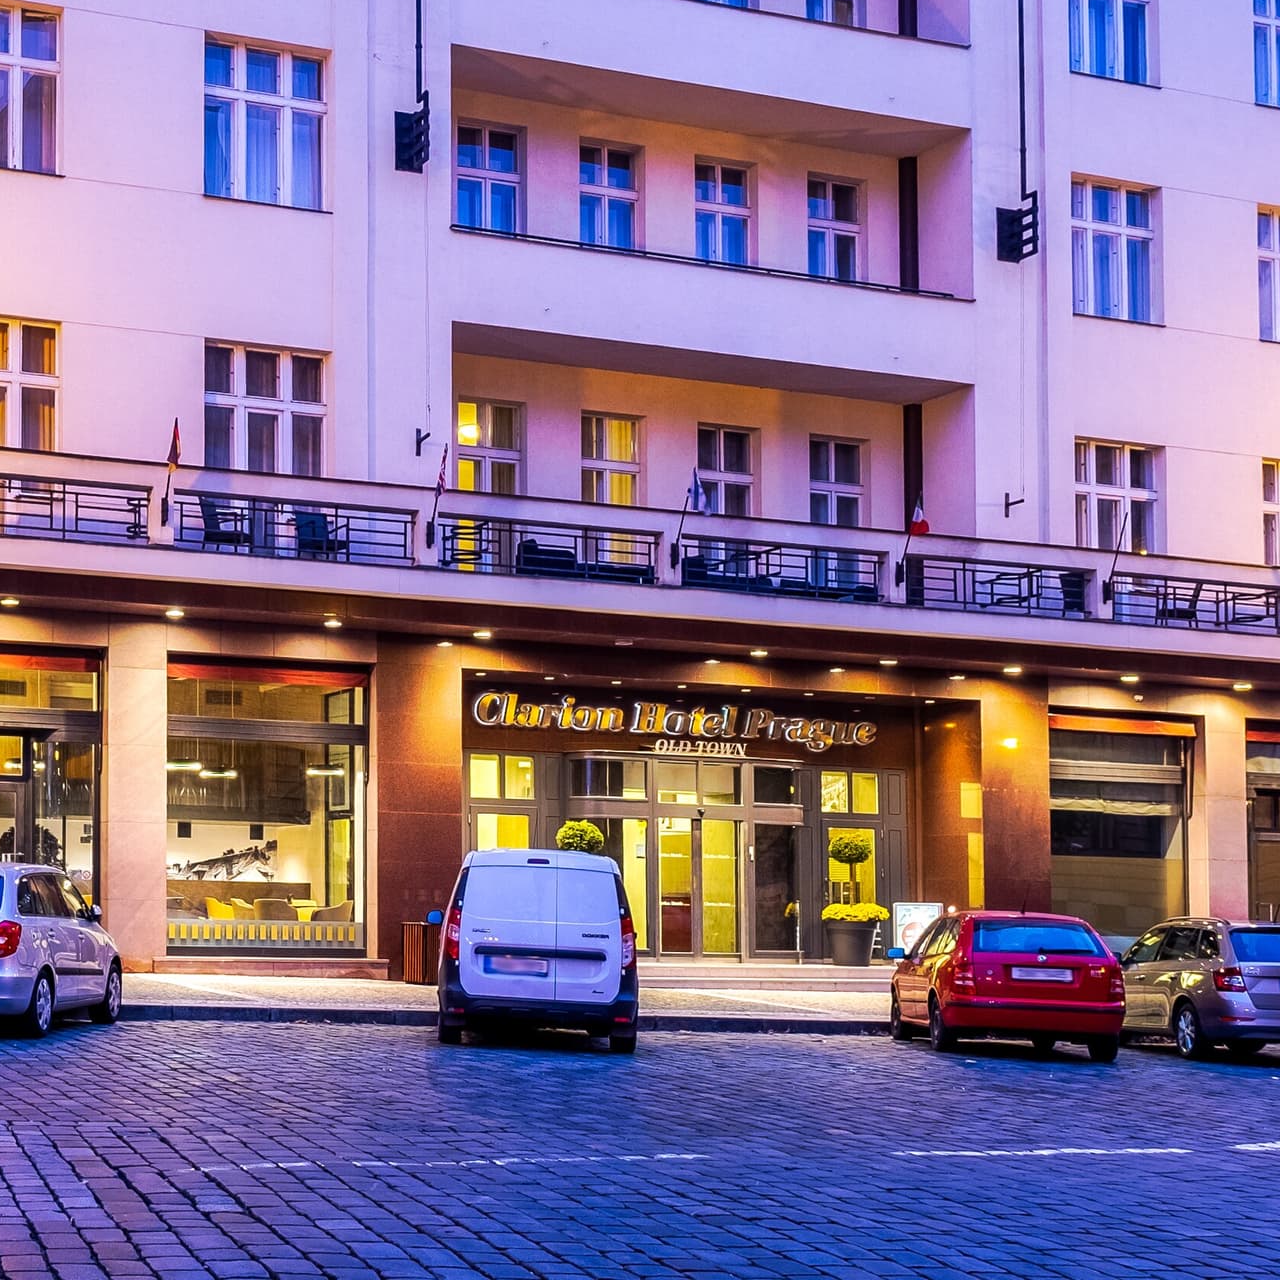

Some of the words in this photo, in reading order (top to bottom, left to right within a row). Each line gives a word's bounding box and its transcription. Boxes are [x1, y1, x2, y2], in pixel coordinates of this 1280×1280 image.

[474, 691, 624, 732] Clarion
[630, 701, 738, 738] Hotel
[740, 708, 877, 752] Prague
[654, 738, 692, 754] OLD
[695, 740, 748, 757] TOWN
